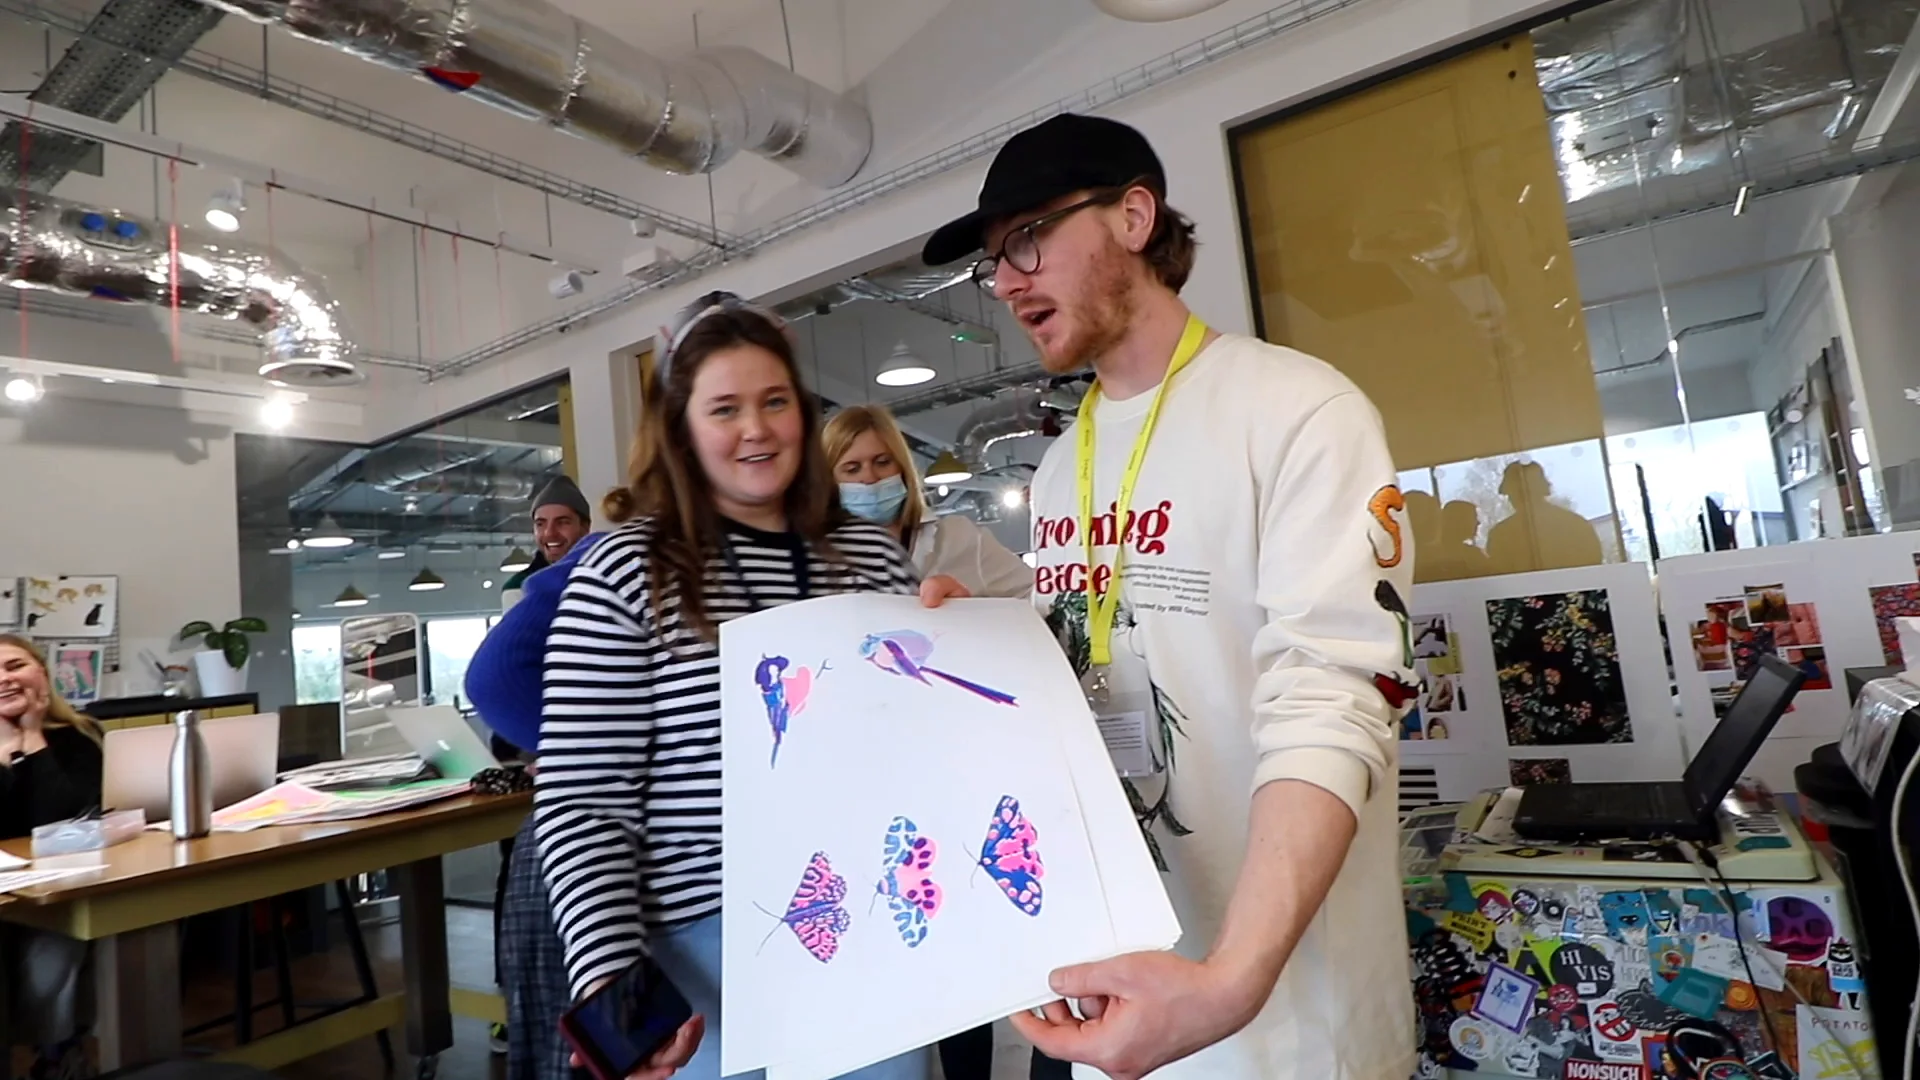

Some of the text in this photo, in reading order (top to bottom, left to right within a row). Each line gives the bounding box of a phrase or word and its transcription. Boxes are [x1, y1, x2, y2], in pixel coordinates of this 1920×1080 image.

[1560, 950, 1582, 966] HI
[1574, 965, 1611, 982] VIS
[1567, 1062, 1639, 1080] NONSUCH
